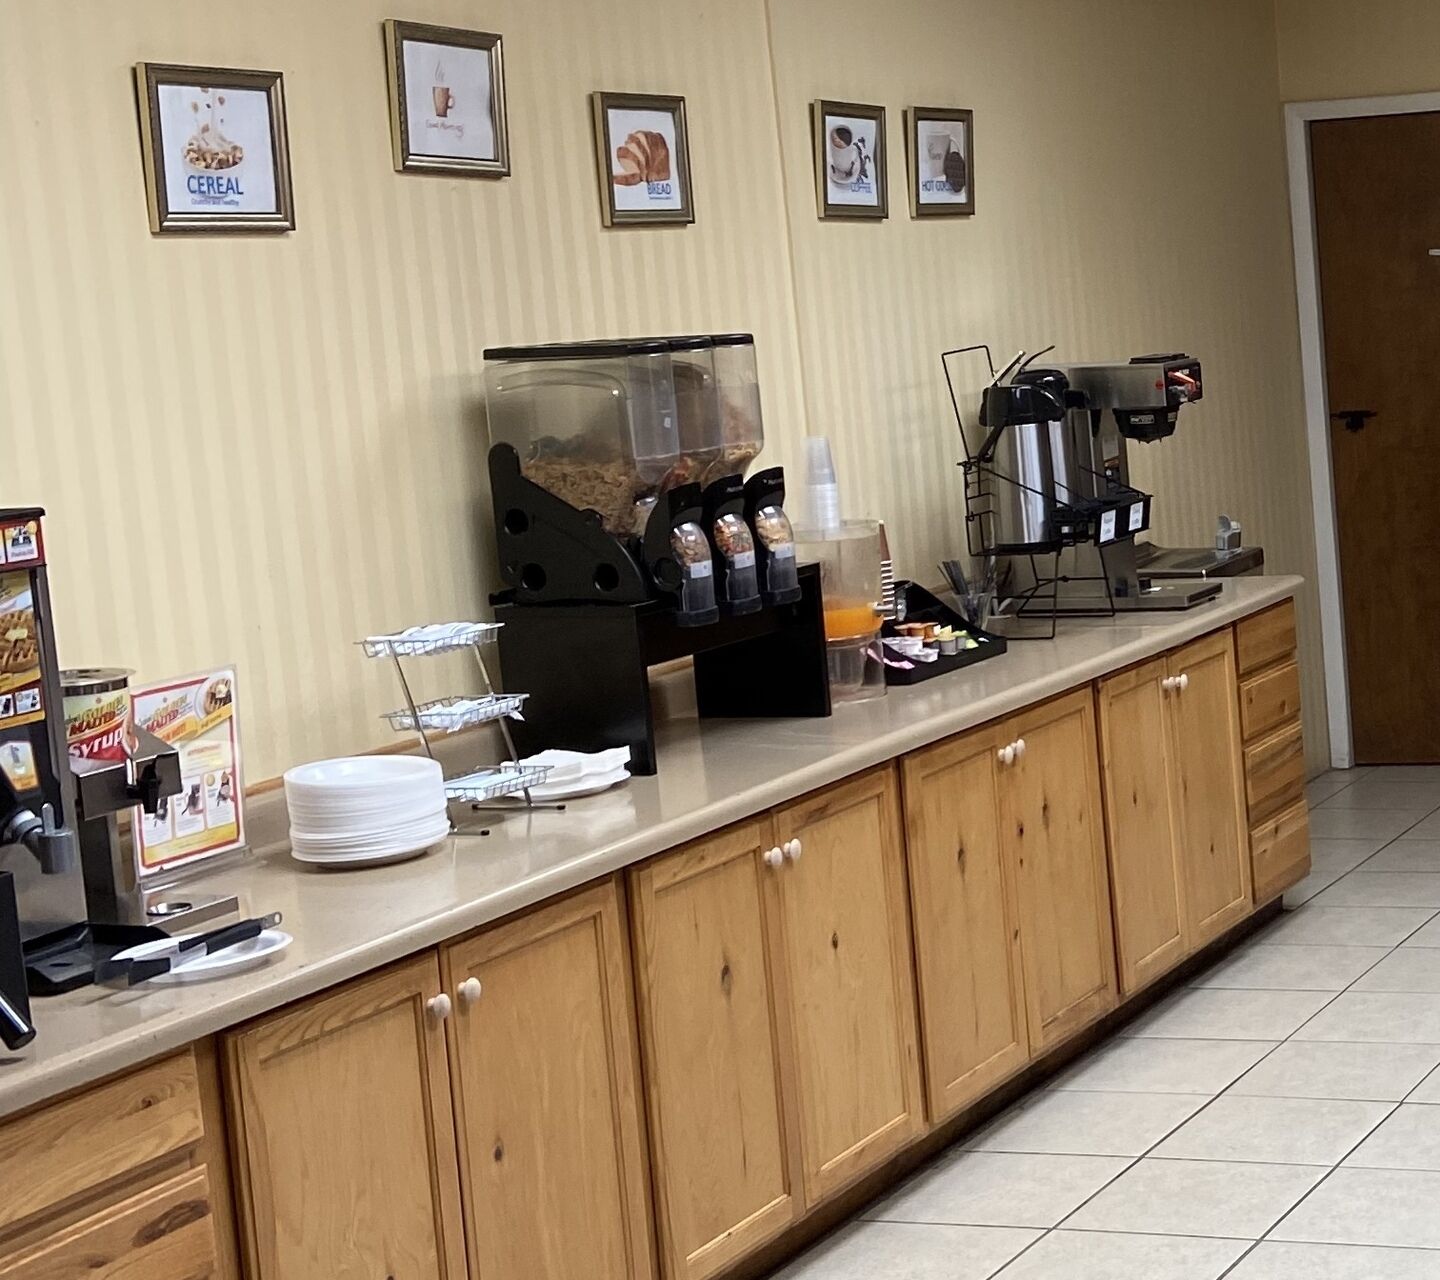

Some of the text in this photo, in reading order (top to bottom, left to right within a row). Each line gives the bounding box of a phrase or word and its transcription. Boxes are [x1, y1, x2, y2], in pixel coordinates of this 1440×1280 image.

[187, 174, 244, 195] CEREAL
[647, 182, 672, 195] BREAD
[921, 180, 935, 192] HOT
[68, 728, 124, 759] Syrup
